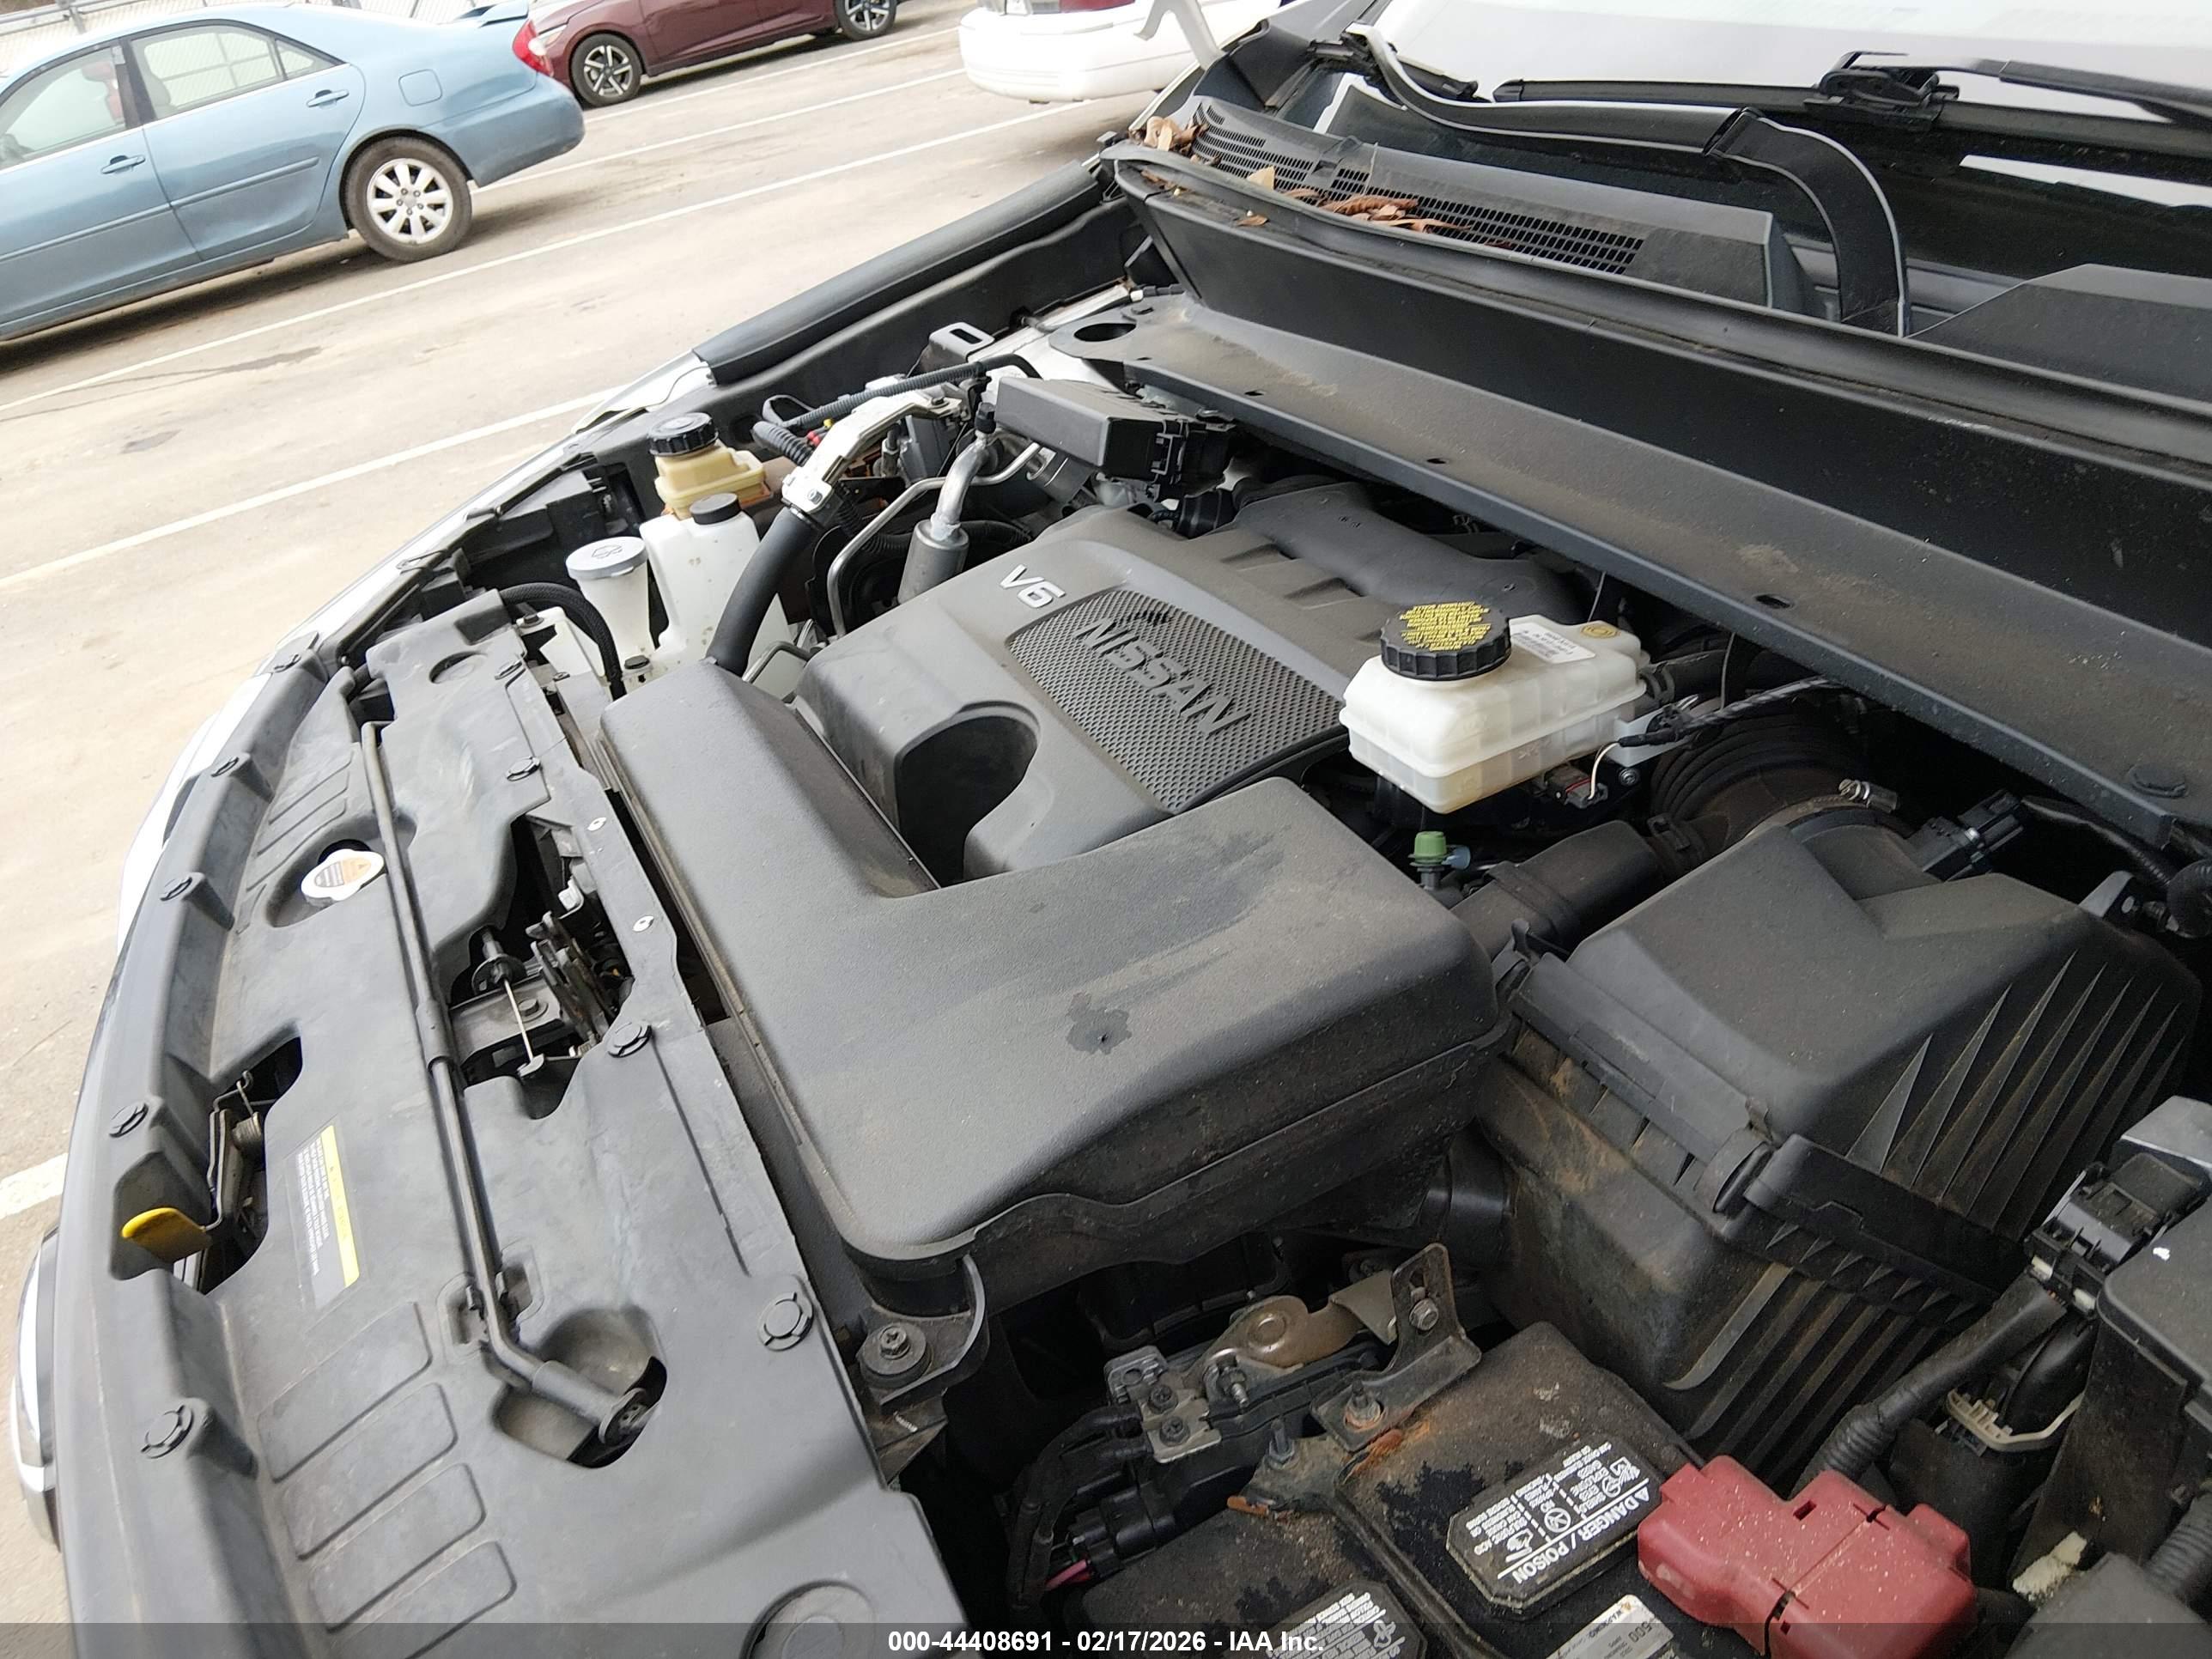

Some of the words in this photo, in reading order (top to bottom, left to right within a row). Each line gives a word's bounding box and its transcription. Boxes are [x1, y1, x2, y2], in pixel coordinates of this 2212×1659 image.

[1000, 564, 1066, 609] V6
[1073, 616, 1252, 739] NISSAN
[1577, 1495, 1637, 1541] DANGER
[1511, 1540, 1569, 1583] POISON
[1628, 1620, 1653, 1644] 500
